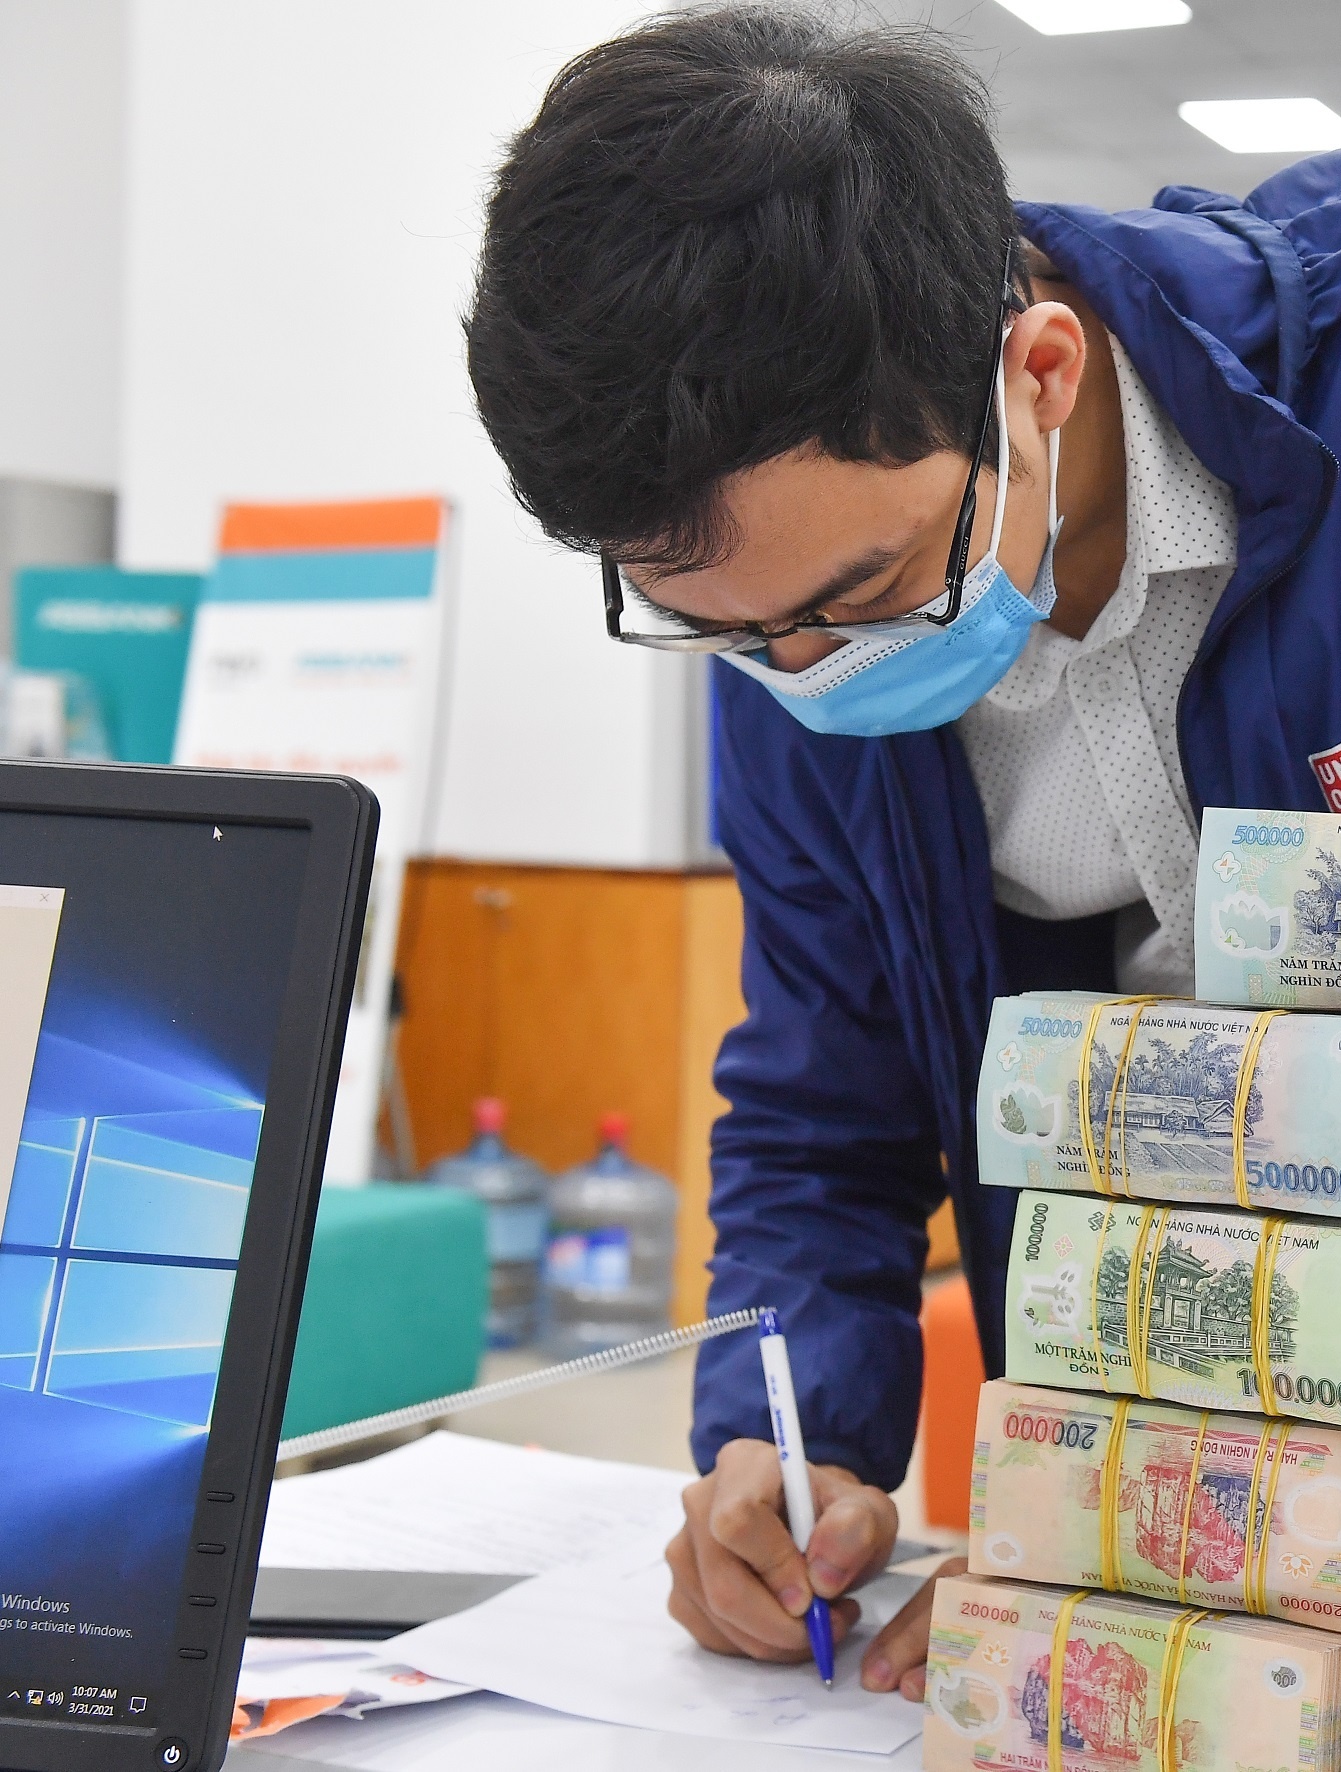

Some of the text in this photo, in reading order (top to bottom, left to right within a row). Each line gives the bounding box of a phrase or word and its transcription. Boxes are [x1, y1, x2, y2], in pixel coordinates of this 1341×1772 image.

[1280, 956, 1308, 969] NĂM
[1280, 974, 1321, 986] NGHÌN
[1138, 1017, 1164, 1028] HÀNG
[1166, 1017, 1187, 1029] NHÀ
[1190, 1020, 1219, 1031] NƯỚC
[1221, 1022, 1244, 1035] VIỆT
[1056, 1144, 1119, 1160] NĂM RĂM
[1196, 1223, 1220, 1237] NHÀ
[1223, 1227, 1260, 1242] NƯỚC
[1292, 1238, 1320, 1250] NAM
[1035, 1341, 1132, 1367] MỘT TRĂM NGHÌ
[1, 1594, 70, 1614] Windows
[16, 1618, 28, 1630] to
[31, 1620, 76, 1634] activate
[79, 1622, 133, 1638] Windows.
[1104, 1622, 1127, 1635] NHÀ
[1186, 1638, 1211, 1651] NAM
[72, 1686, 118, 1699] 10:07 AM
[68, 1702, 114, 1716] 3/31/2021
